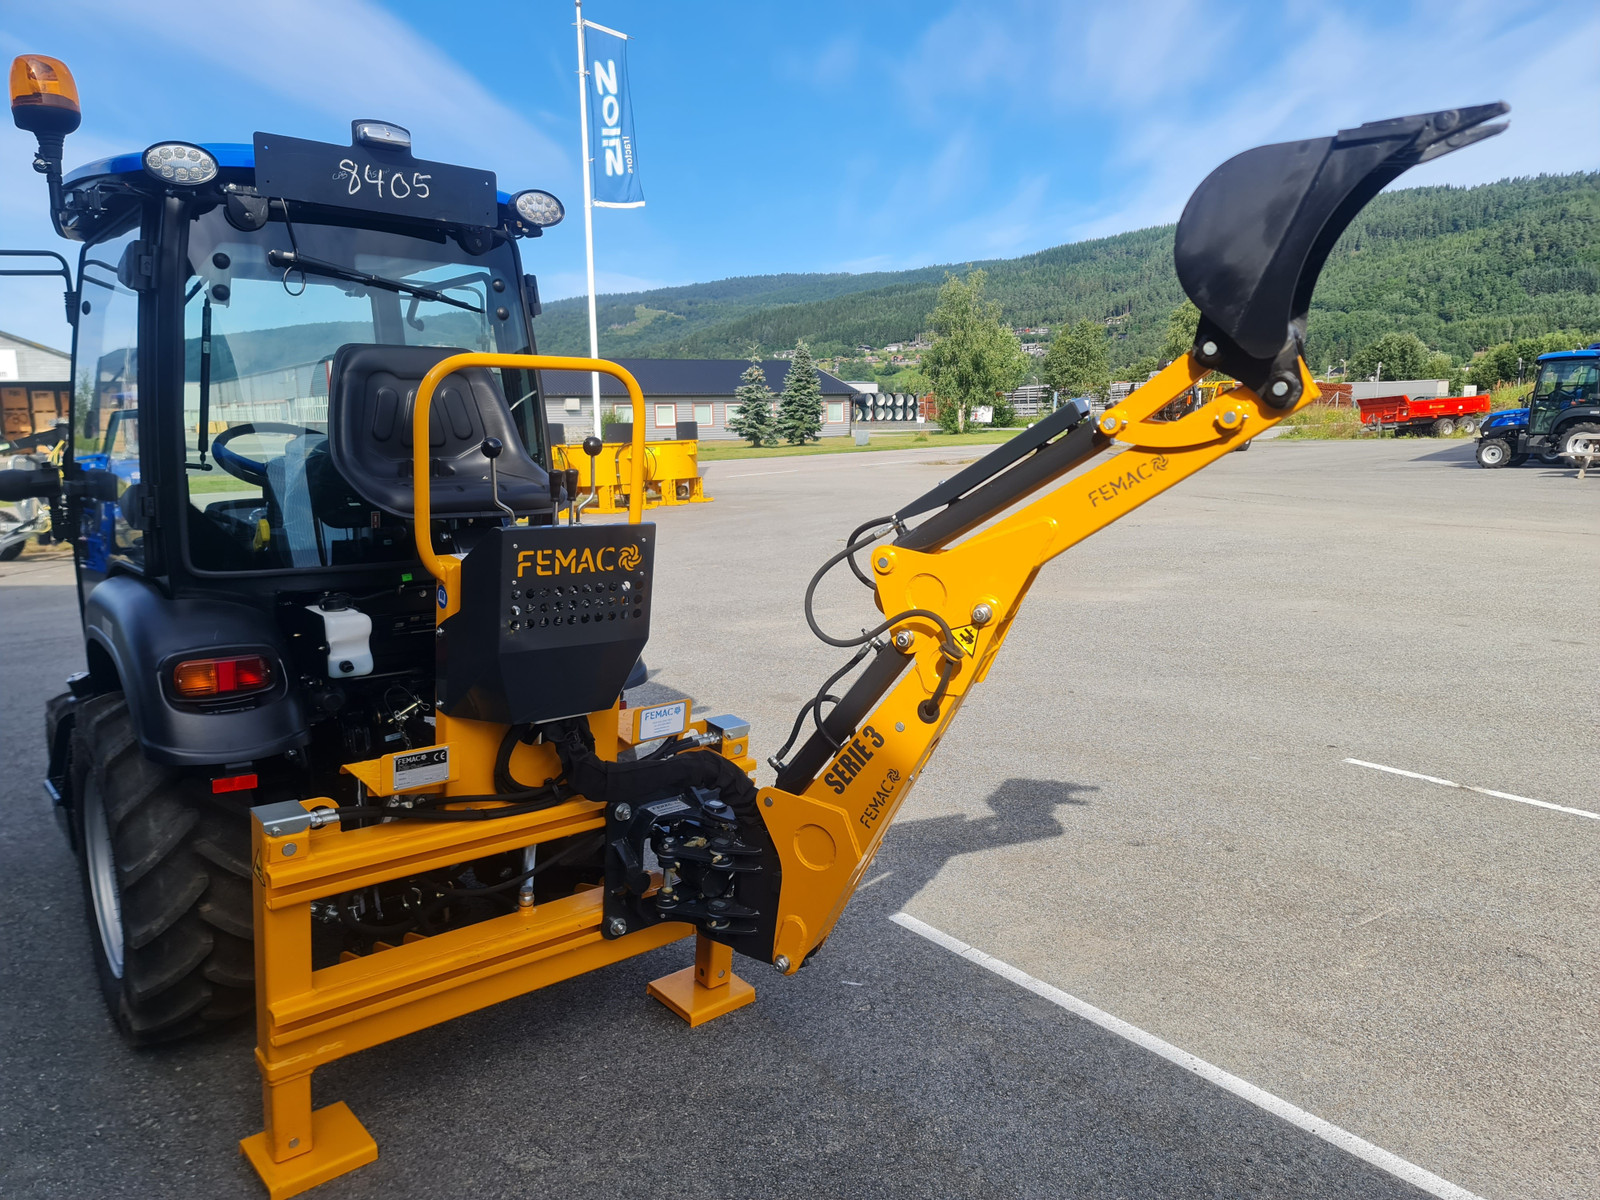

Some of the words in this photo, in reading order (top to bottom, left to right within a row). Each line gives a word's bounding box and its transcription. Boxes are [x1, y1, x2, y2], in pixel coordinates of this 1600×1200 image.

[339, 158, 432, 199] 8405
[1088, 463, 1153, 508] FEMAC
[517, 547, 616, 578] FEMAC
[644, 707, 674, 721] FEMAC
[397, 755, 421, 765] FEMAC
[823, 738, 874, 795] SERIE
[862, 725, 885, 749] 3
[859, 780, 894, 830] FEMAC
